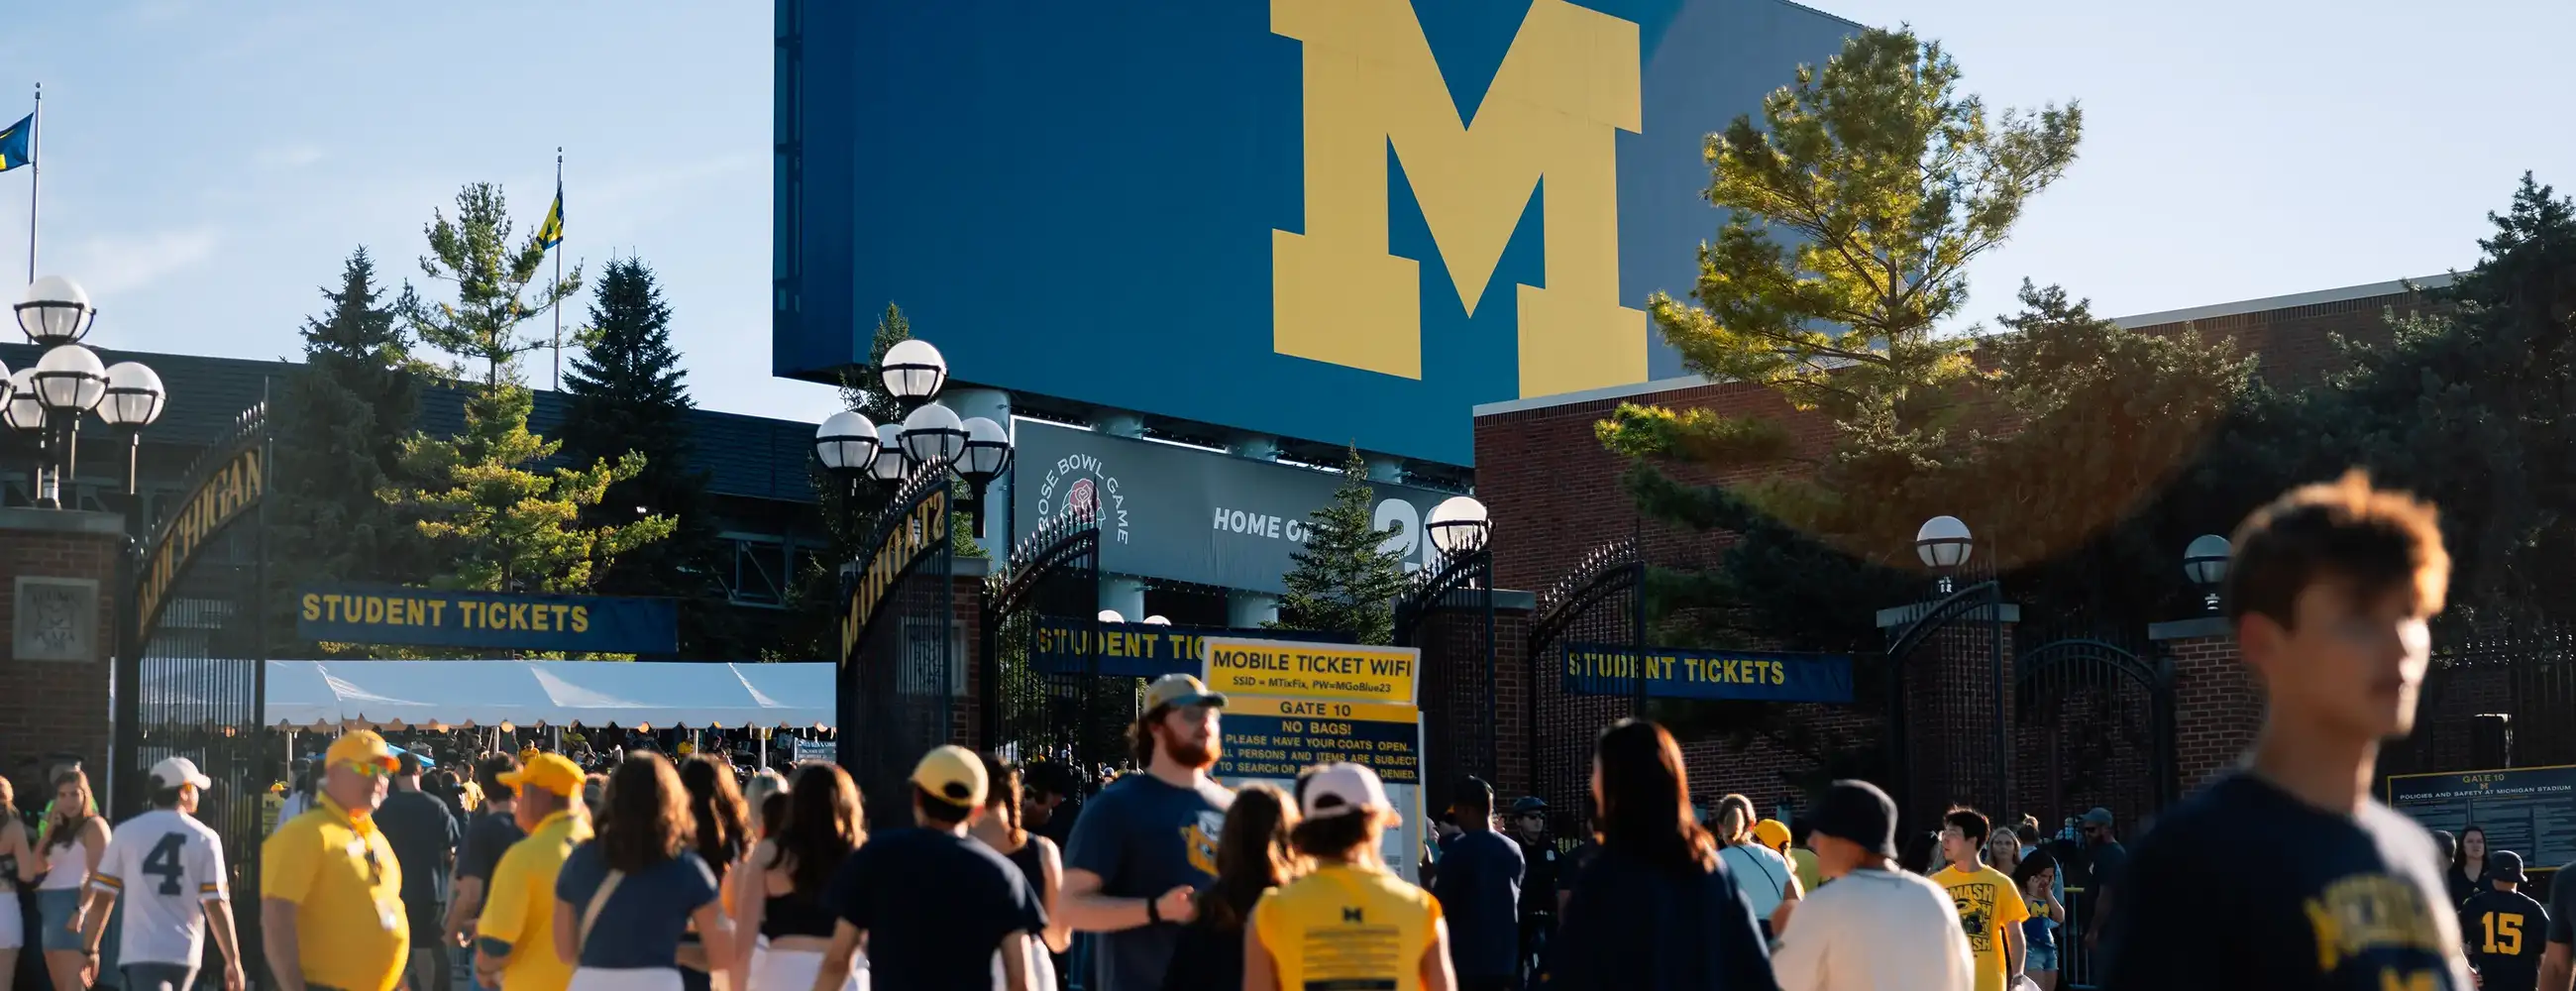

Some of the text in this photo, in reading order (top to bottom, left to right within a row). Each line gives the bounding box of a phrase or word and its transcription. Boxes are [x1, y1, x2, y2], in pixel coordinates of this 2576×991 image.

[1270, 0, 1650, 400] M
[1037, 454, 1128, 545] ROSE BOWL GAME
[1214, 506, 1281, 539] HOME
[138, 444, 263, 637] MICHIGAN
[302, 594, 590, 633] STUDENT TICKETS
[1214, 650, 1411, 677] MOBILE TICKET WIFI
[1568, 652, 1784, 685] STUDENT TICKETS
[1233, 676, 1256, 686] SSID
[1313, 680, 1391, 693] PW=MGoBlue23
[1280, 701, 1351, 716] GATE 10
[1282, 720, 1352, 735] NO BAGS!
[1226, 734, 1267, 745] PLEASE
[1272, 736, 1301, 746] HAVE
[1306, 737, 1336, 748] YOUR
[1339, 739, 1373, 750] COATS
[1220, 761, 1234, 772] TO
[1237, 762, 1279, 773] SEARCH
[1281, 764, 1296, 773] OR
[1380, 768, 1418, 779] DENIED.
[1222, 748, 1418, 766] LL PERSONS AND ITEMS ARE SUBJECT
[2463, 773, 2505, 783] GATE 10
[142, 831, 188, 896] 4
[2031, 903, 2050, 919] M
[2481, 911, 2524, 955] 15
